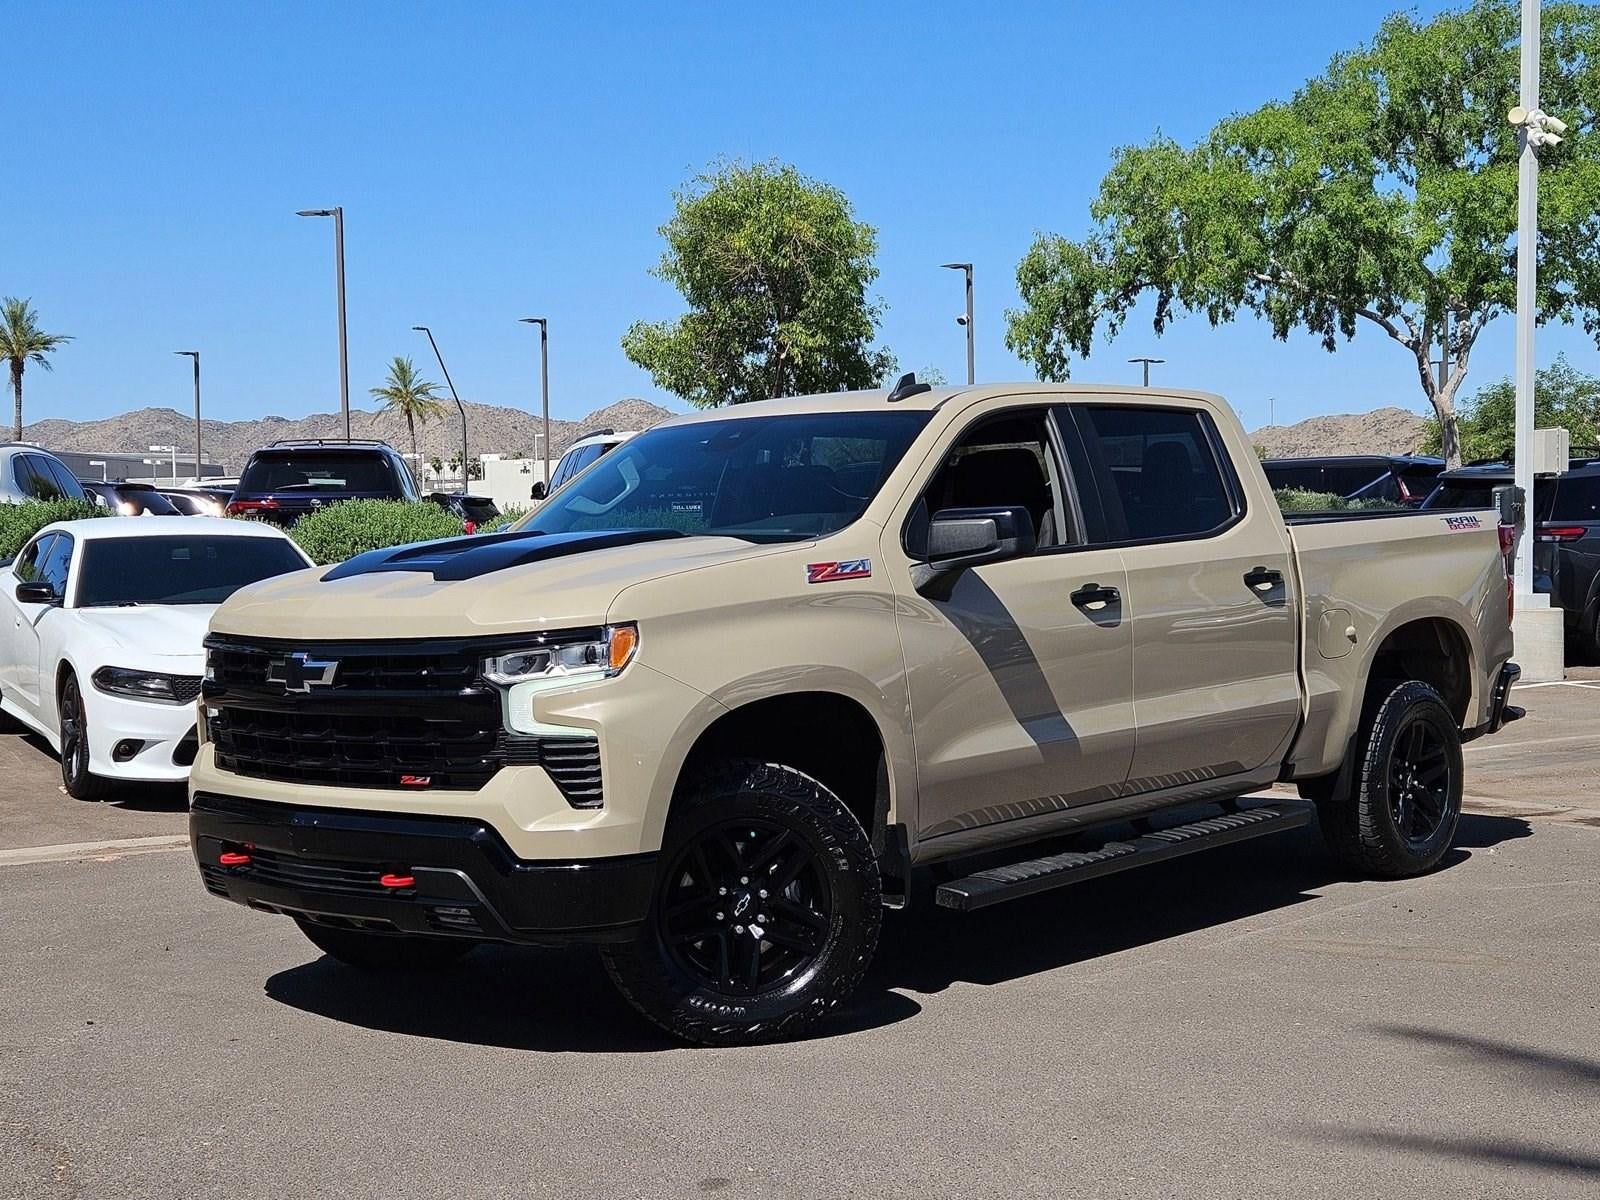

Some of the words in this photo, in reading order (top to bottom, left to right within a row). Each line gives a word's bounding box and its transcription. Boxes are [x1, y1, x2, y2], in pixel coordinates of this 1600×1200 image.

[1440, 515, 1482, 525] TRAIL
[1449, 522, 1480, 531] BOSS
[807, 560, 872, 583] Z71
